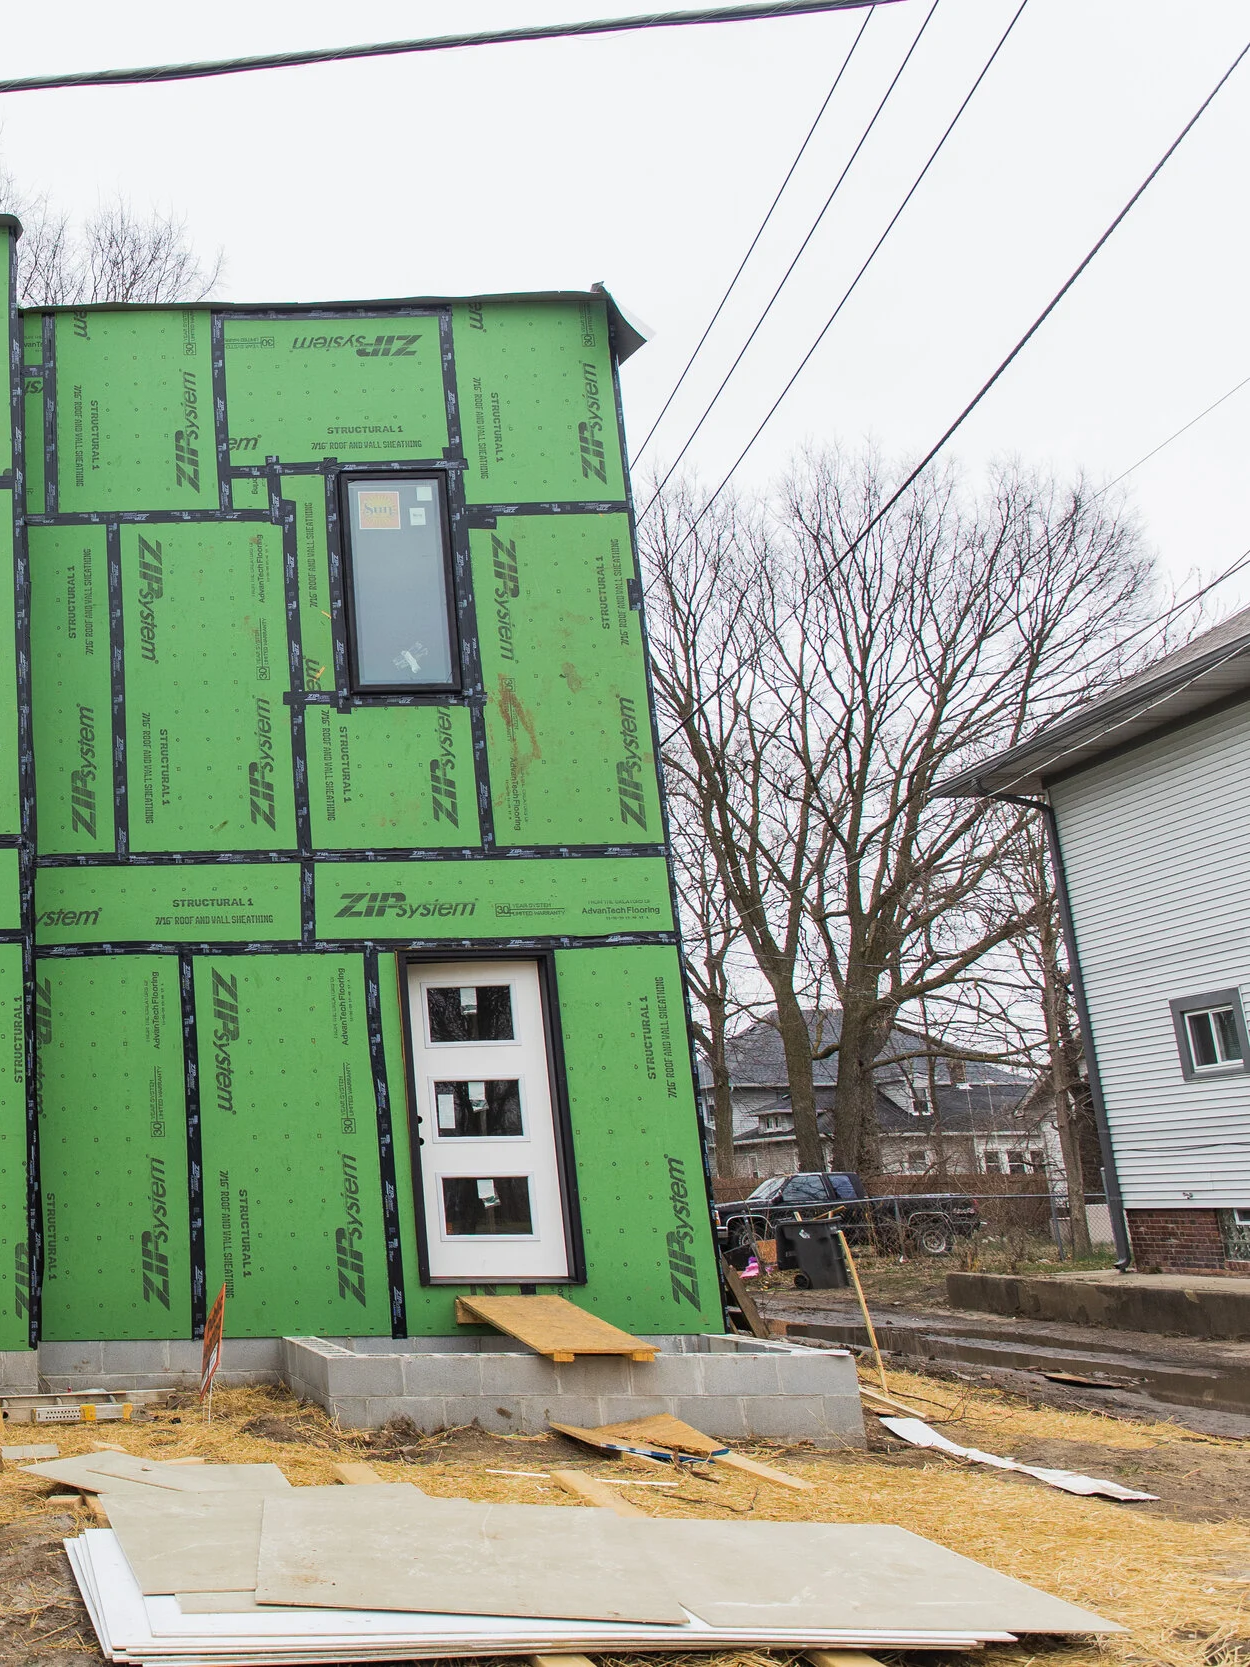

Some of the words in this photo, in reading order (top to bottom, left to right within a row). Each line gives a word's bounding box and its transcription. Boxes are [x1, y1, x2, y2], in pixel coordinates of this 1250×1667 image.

[185, 343, 195, 354] 30
[583, 335, 594, 346] 30
[91, 400, 100, 462] STRUCTURAL
[327, 425, 394, 434] STRUCTURAL
[397, 425, 403, 433] 1
[491, 393, 503, 454] STRUCTURAL
[67, 574, 76, 638] STRUCTURAL
[596, 564, 610, 629] STRUCTURAL
[160, 729, 170, 796] STRUCTURAL
[339, 726, 351, 794] STRUCTURAL
[173, 898, 244, 908] STRUCTURAL
[248, 898, 254, 906] 1
[497, 905, 509, 916] 30
[582, 907, 625, 915] AdvanTech
[626, 906, 660, 915] Flooring
[152, 972, 160, 1005] Flooring
[338, 968, 347, 1002] Flooring
[14, 1006, 23, 1084] STRUCTURAL
[152, 1006, 160, 1049] AdvanTech
[340, 1003, 349, 1045] AdvanTech
[640, 1006, 656, 1079] STRUCTURAL
[153, 1123, 164, 1136] 30
[343, 1119, 355, 1133] 30
[47, 1193, 57, 1270] STRUCTURAL
[239, 1189, 251, 1267] STRUCTURAL
